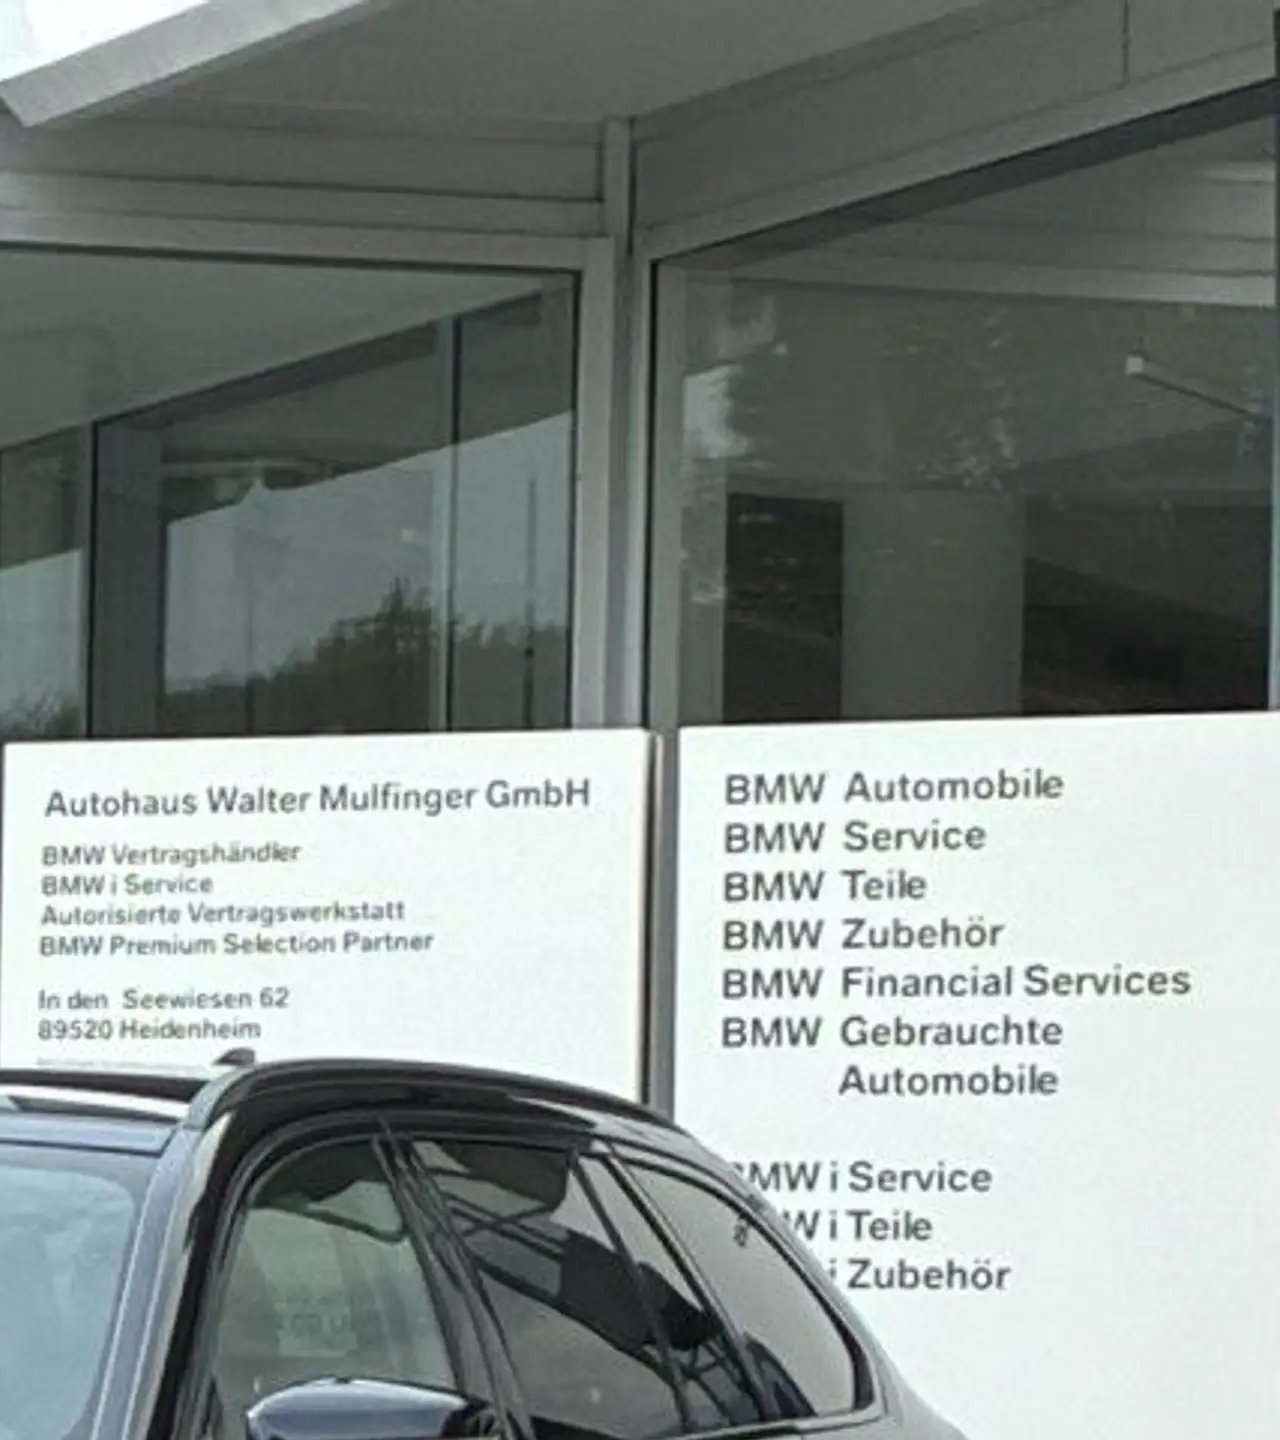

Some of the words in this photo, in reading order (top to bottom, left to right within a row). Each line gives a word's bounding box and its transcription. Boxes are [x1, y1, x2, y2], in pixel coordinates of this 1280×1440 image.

[44, 788, 199, 818] Autohaus
[206, 785, 312, 815] Walter
[319, 781, 479, 818] Mulfinger
[485, 777, 590, 809] GmbH
[724, 772, 827, 805] BMW
[843, 767, 1065, 802] Automobile
[723, 821, 826, 854] BMW
[842, 819, 987, 853] Service
[41, 845, 106, 868] BMW
[111, 841, 301, 869] Vertragshändler
[41, 874, 105, 898] BMW
[123, 872, 213, 896] Service
[722, 870, 826, 903] BMW
[840, 868, 928, 902] Teile
[40, 904, 181, 927] Autorisierte
[187, 900, 405, 928] Vertragswerkstatt
[39, 935, 104, 958] BMW
[109, 933, 217, 956] Premium
[223, 932, 337, 955] Selection
[342, 930, 434, 953] Partner
[722, 918, 825, 952] BMW
[841, 915, 1005, 950] Zubehör
[38, 988, 61, 1011] In
[67, 989, 109, 1011] den
[122, 986, 253, 1011] Seewiesen
[259, 986, 290, 1009] 62
[721, 967, 825, 1000] BMW
[841, 964, 1014, 998] Financial
[1023, 963, 1192, 998] Services
[37, 1018, 115, 1041] 89520
[118, 1017, 262, 1041] Heidenheim
[721, 1015, 823, 1049] BMW
[839, 1013, 1064, 1049] Gebrauchte
[837, 1063, 1060, 1097] Automobile
[829, 1160, 838, 1192] i
[848, 1159, 993, 1193] Service
[829, 1209, 838, 1240] i
[845, 1208, 934, 1242] Teile
[847, 1256, 1012, 1292] Zubehör
